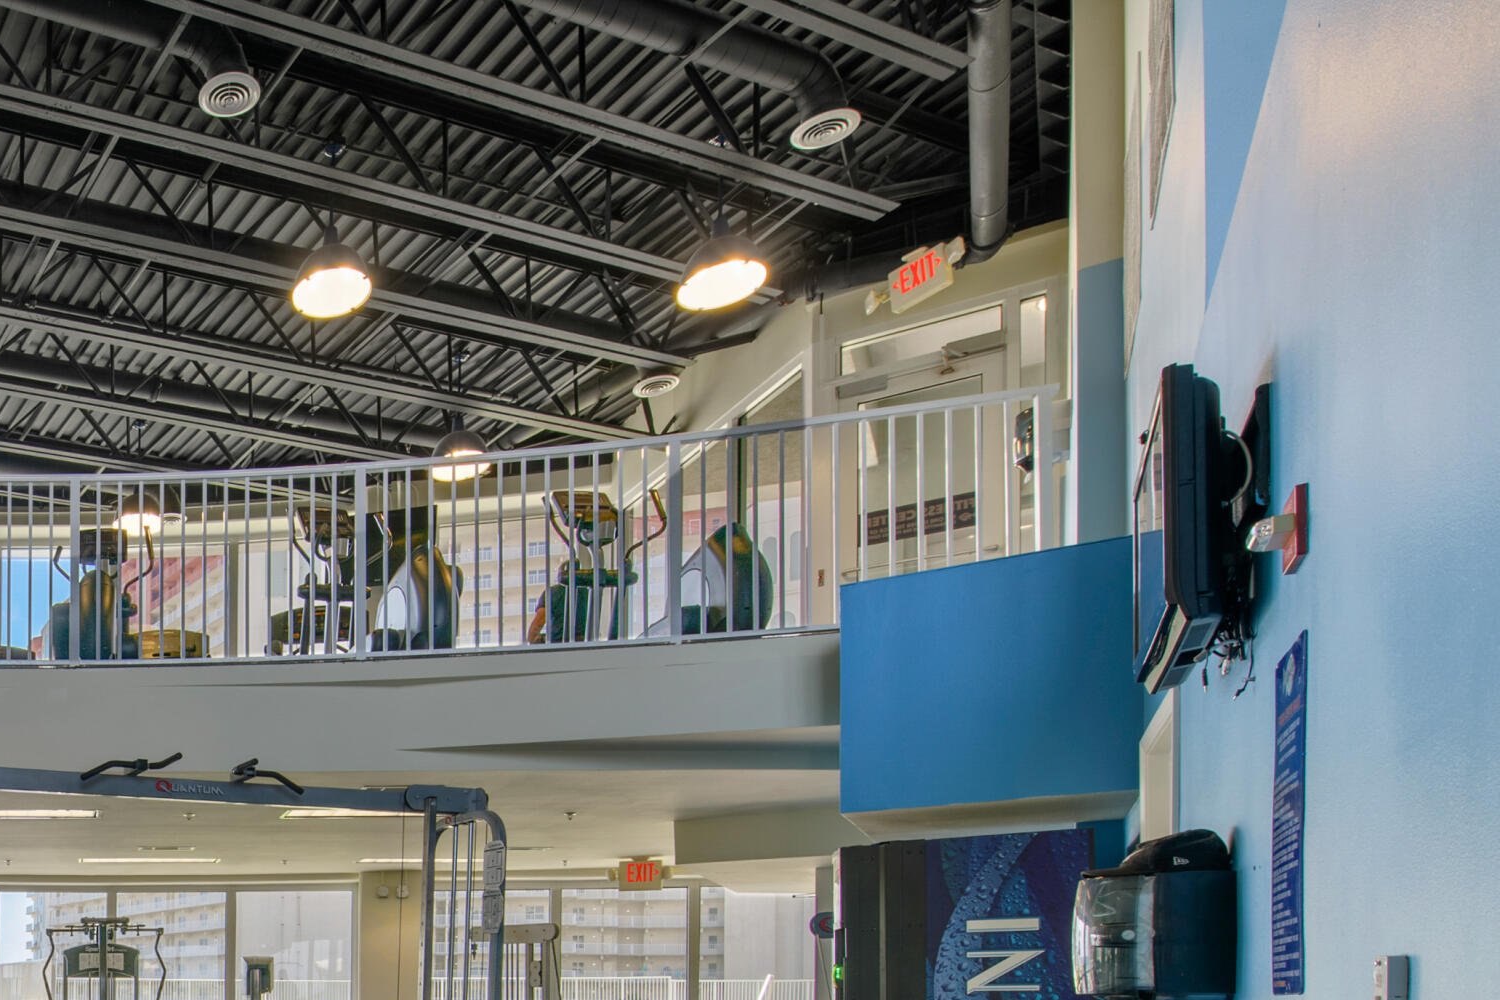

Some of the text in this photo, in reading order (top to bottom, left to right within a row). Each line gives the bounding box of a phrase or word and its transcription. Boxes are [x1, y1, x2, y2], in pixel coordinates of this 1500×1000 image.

[899, 250, 937, 295] EXIT
[155, 779, 224, 796] QUANTUM
[627, 862, 655, 883] EXIT
